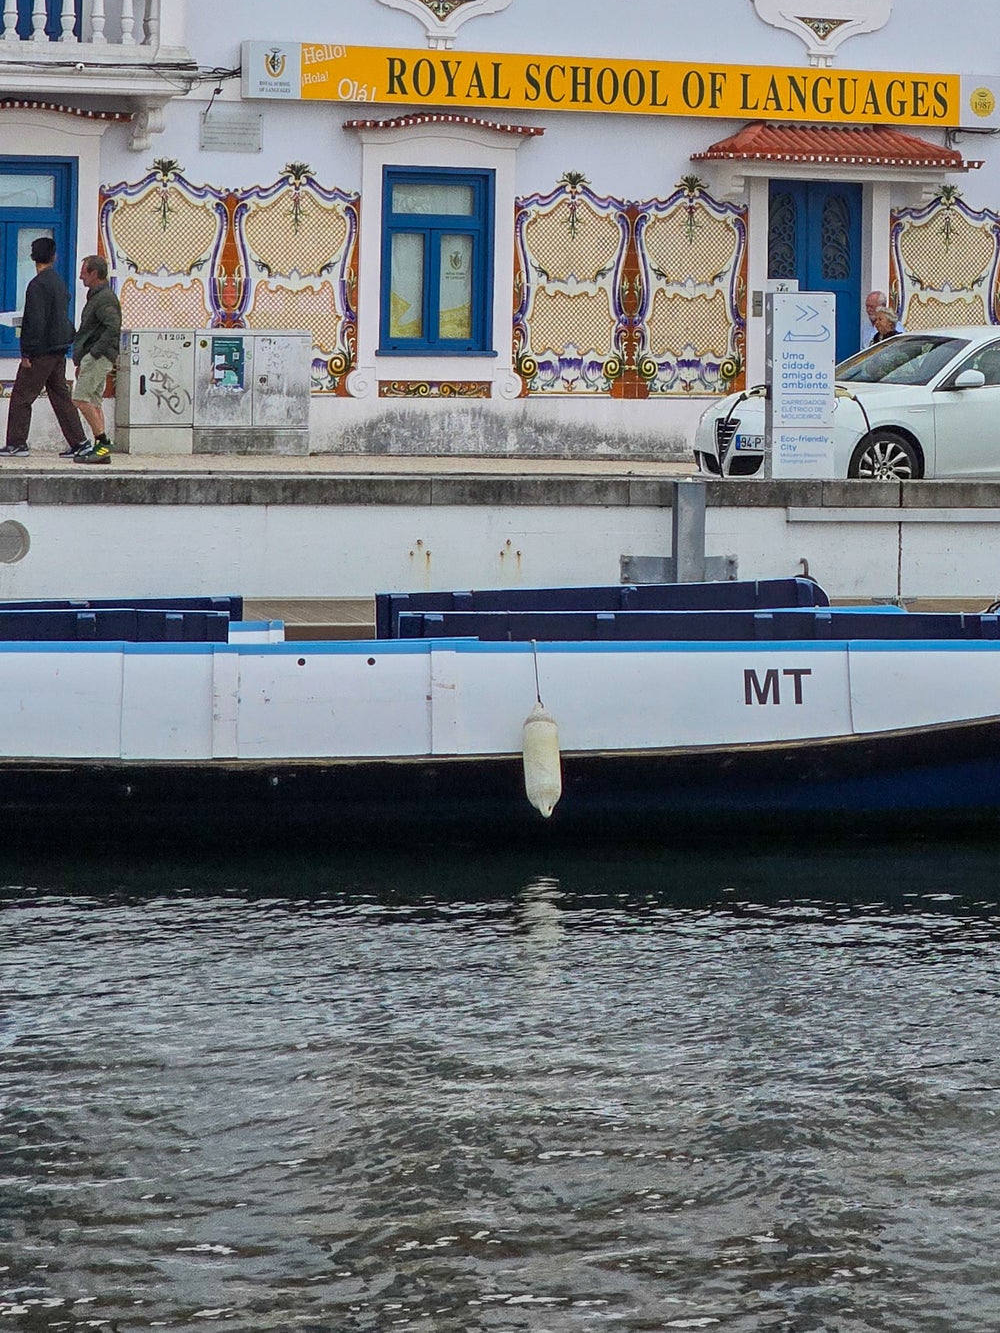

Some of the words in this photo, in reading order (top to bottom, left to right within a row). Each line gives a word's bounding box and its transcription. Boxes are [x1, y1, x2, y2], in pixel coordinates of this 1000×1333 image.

[303, 44, 347, 65] Hello!
[386, 57, 511, 99] ROYAL
[524, 63, 669, 107] SCHOOL
[682, 70, 726, 109] OF
[740, 73, 948, 118] LANGUAGES
[974, 101, 991, 109] 1987
[782, 352, 805, 360] Uma
[781, 362, 815, 370] cidade
[781, 371, 813, 381] amiga
[815, 371, 828, 380] do
[781, 381, 831, 390] ambiente.
[780, 435, 829, 444] Eco-friendly
[780, 444, 797, 453] City
[744, 668, 812, 705] MT
